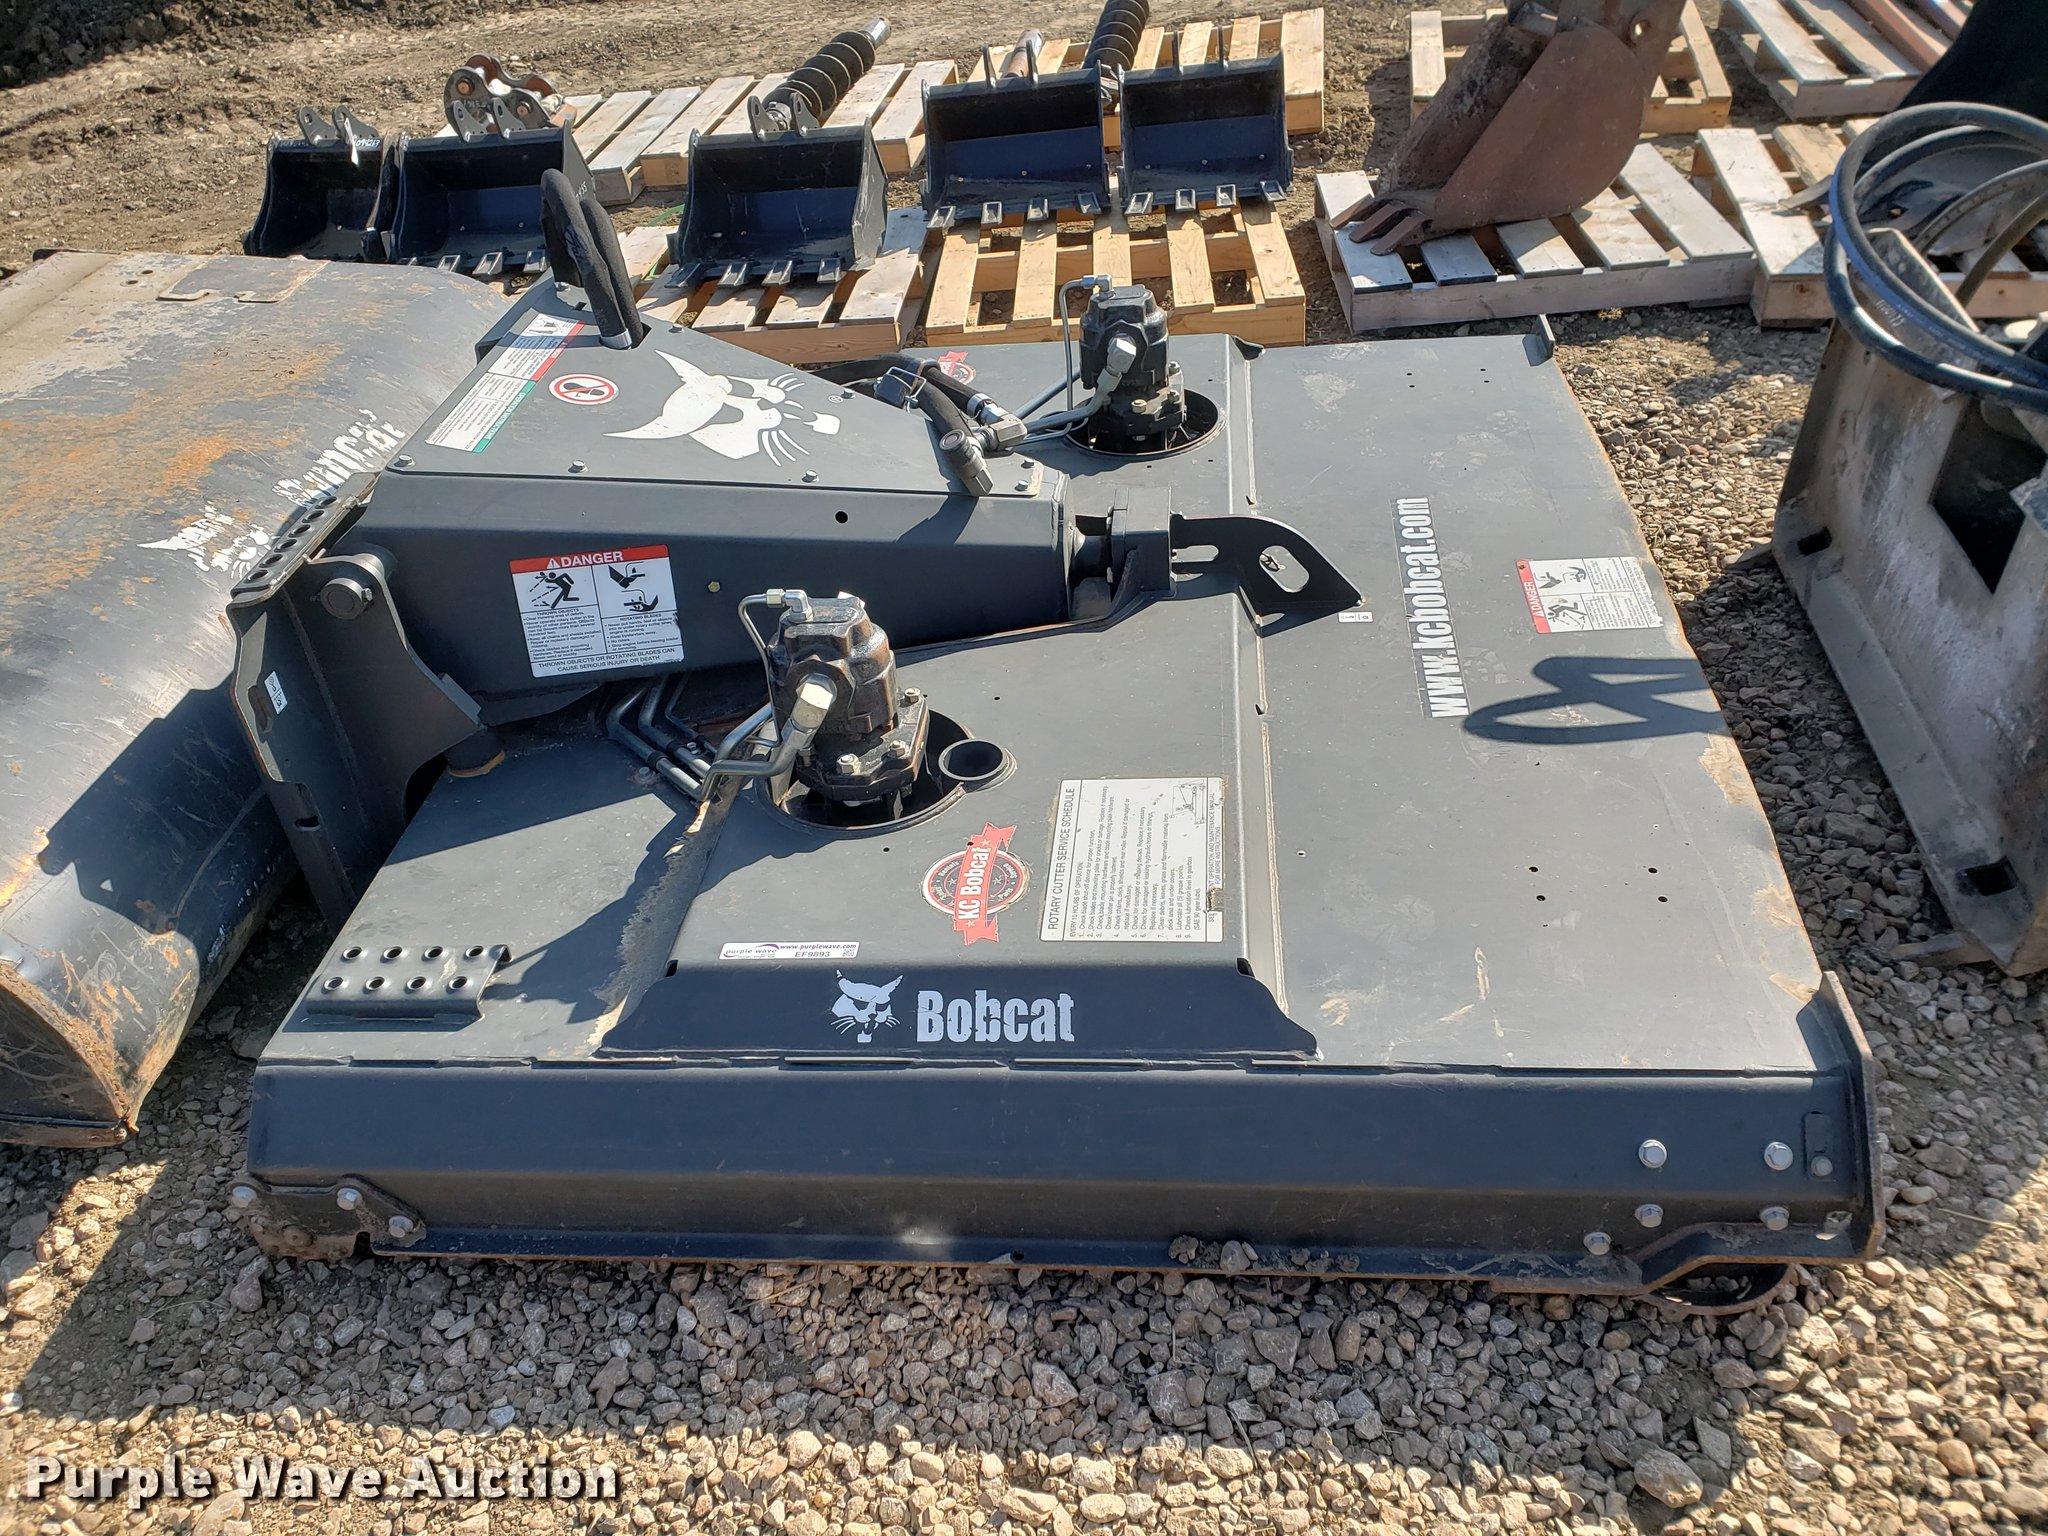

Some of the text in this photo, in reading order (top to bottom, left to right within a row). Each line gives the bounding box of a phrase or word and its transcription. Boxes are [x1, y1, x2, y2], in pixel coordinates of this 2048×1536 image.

[561, 551, 624, 568] DANGER
[1396, 497, 1470, 718] www.kcbobcat.com
[1524, 581, 1542, 611] DANGER
[538, 660, 565, 668] THROWN
[579, 661, 605, 669] SERIOUS
[1047, 789, 1074, 929] ROTARY CUTTER SERVICE SCHEDULE
[958, 847, 992, 920] KC Bobcat
[917, 990, 1075, 1042] Bobcat
